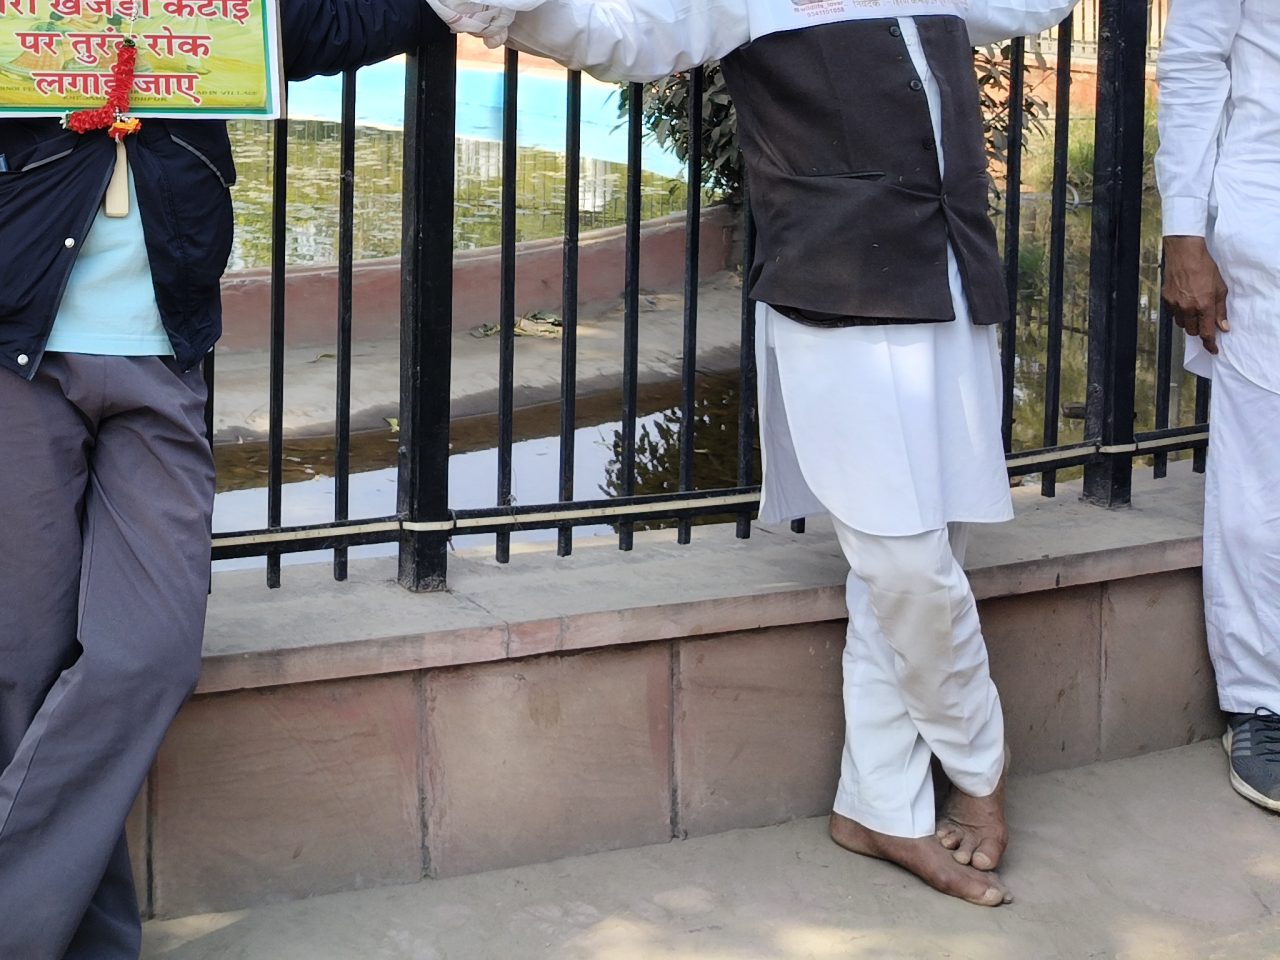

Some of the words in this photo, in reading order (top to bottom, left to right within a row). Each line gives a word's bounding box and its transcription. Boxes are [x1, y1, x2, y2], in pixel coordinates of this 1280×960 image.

[16, 32, 61, 55] पर
[67, 26, 138, 64] तुरं
[143, 27, 211, 57] रोक
[132, 74, 200, 104] जाए
